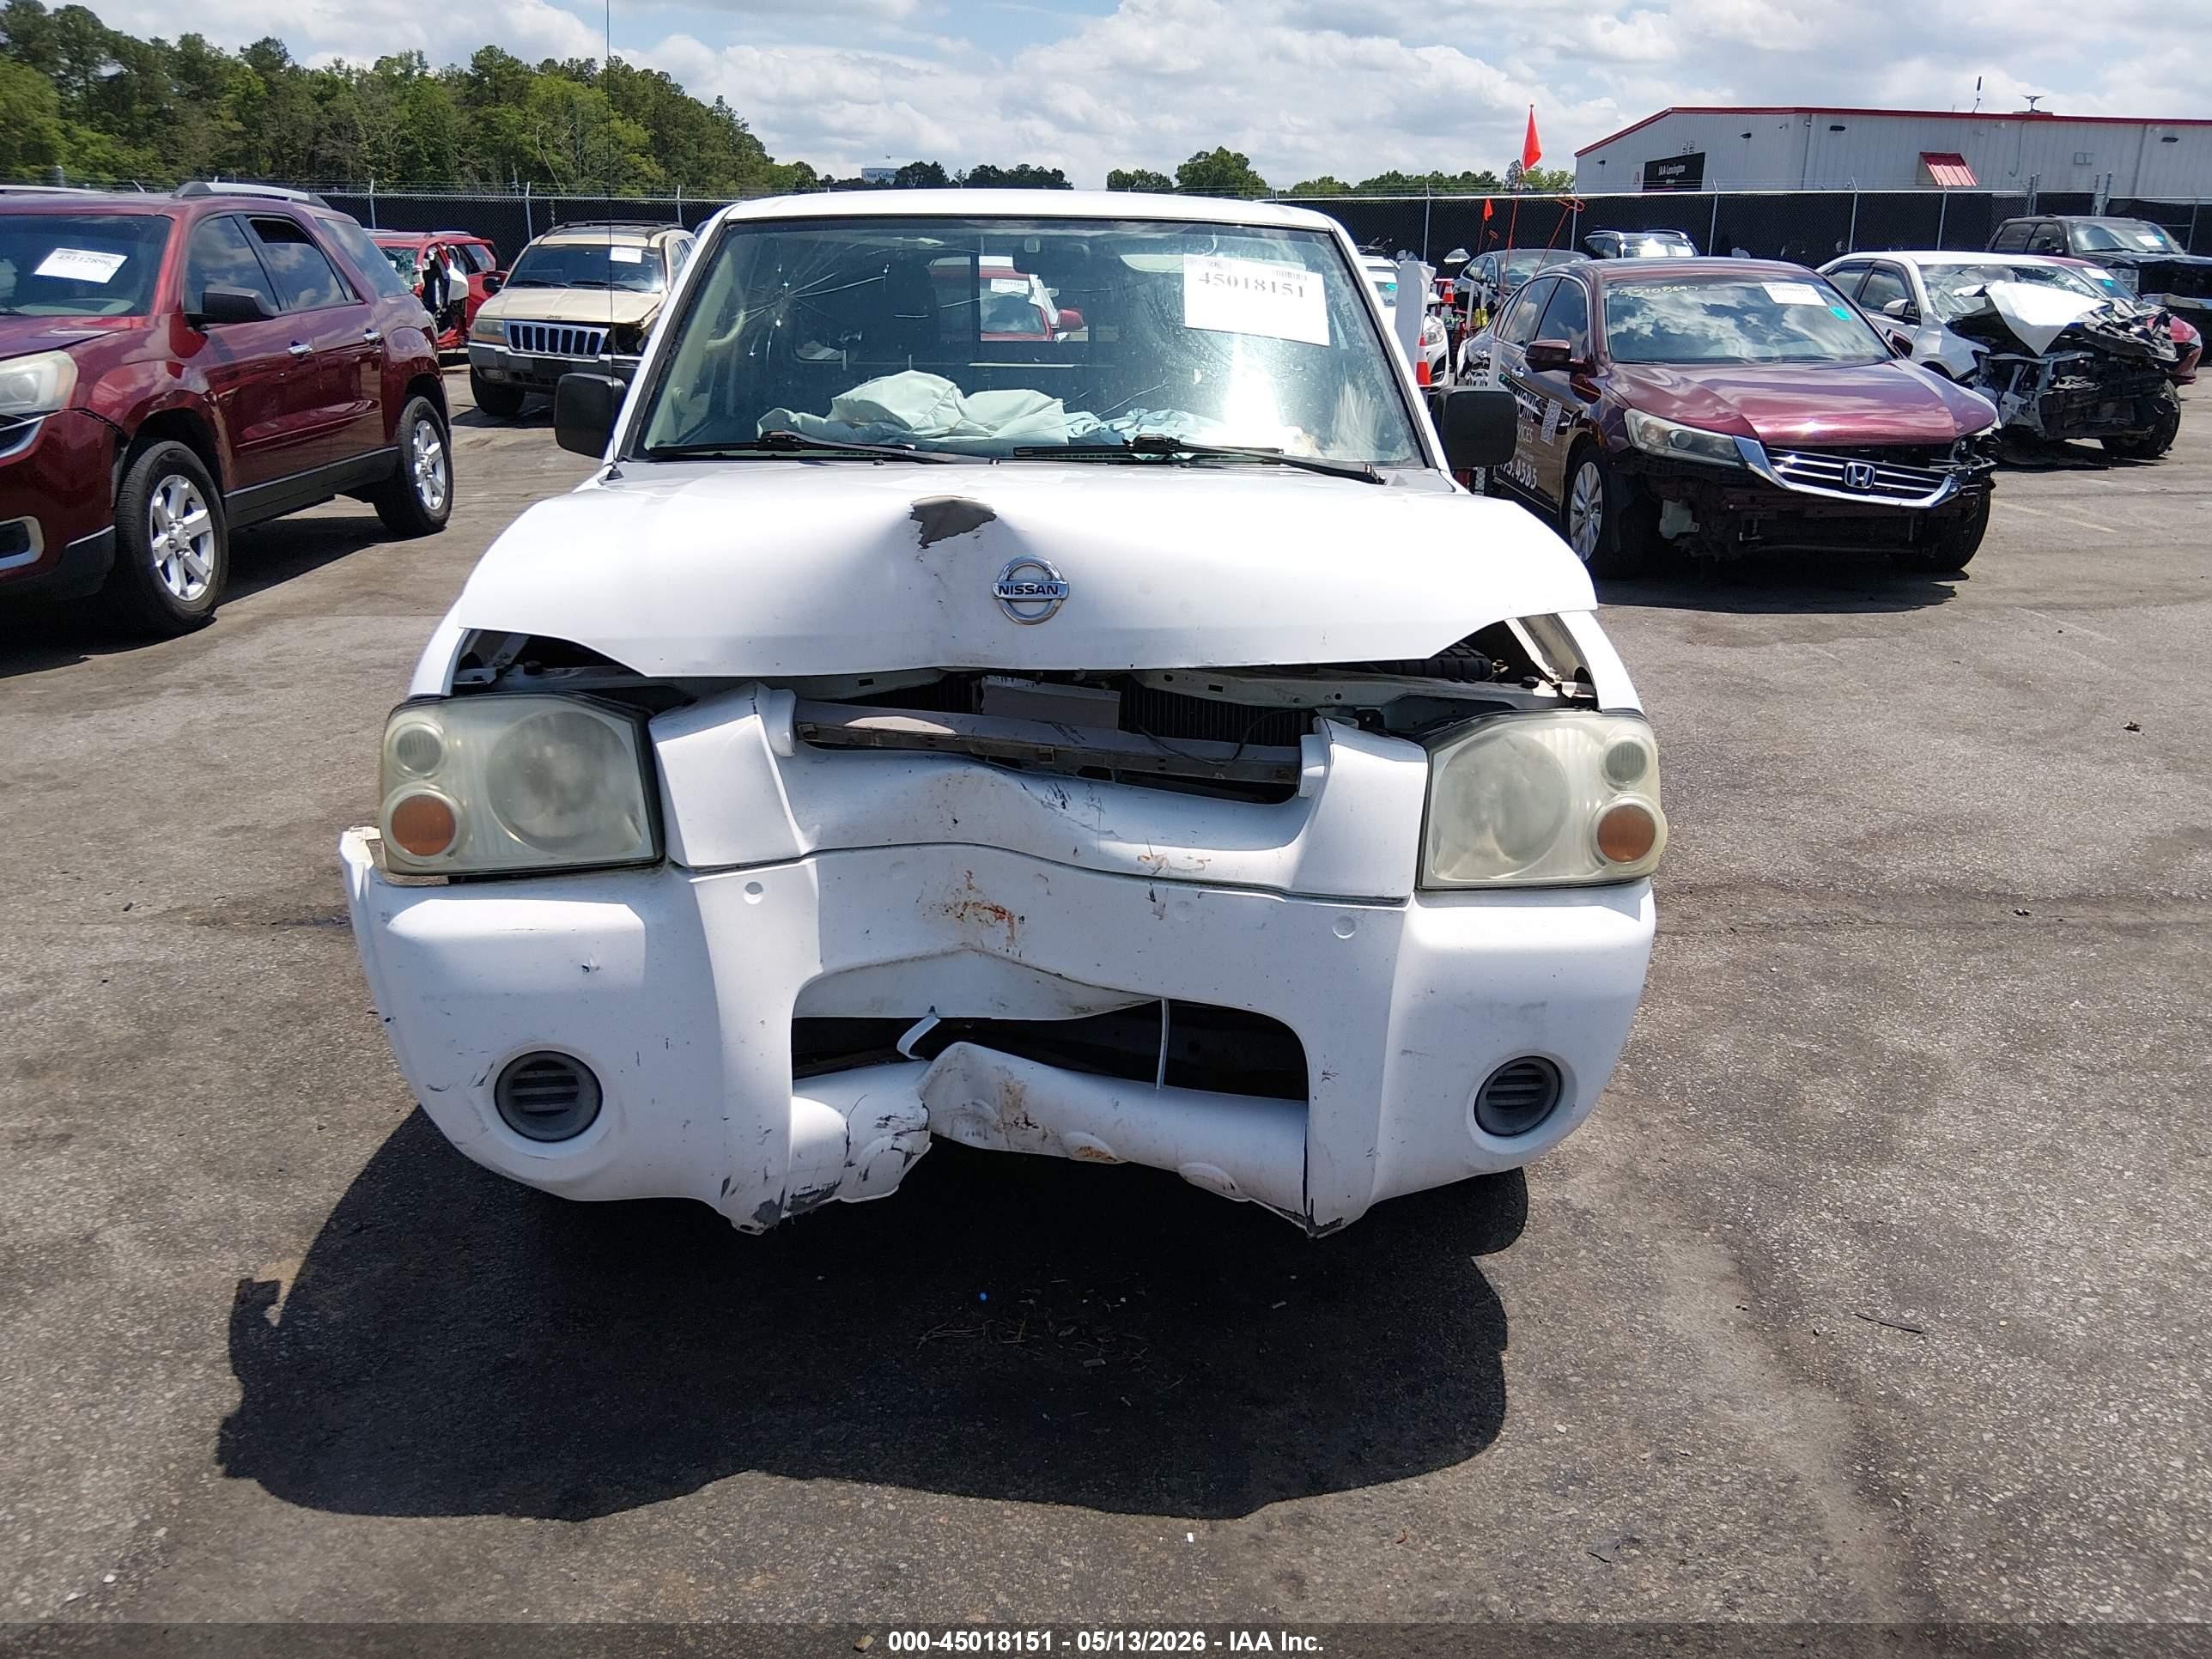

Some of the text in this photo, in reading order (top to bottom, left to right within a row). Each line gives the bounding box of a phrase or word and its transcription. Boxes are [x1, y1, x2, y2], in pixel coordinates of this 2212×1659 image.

[1199, 271, 1304, 299] 45018151
[1516, 422, 1533, 444] VICES
[999, 585, 1058, 595] NISSAN
